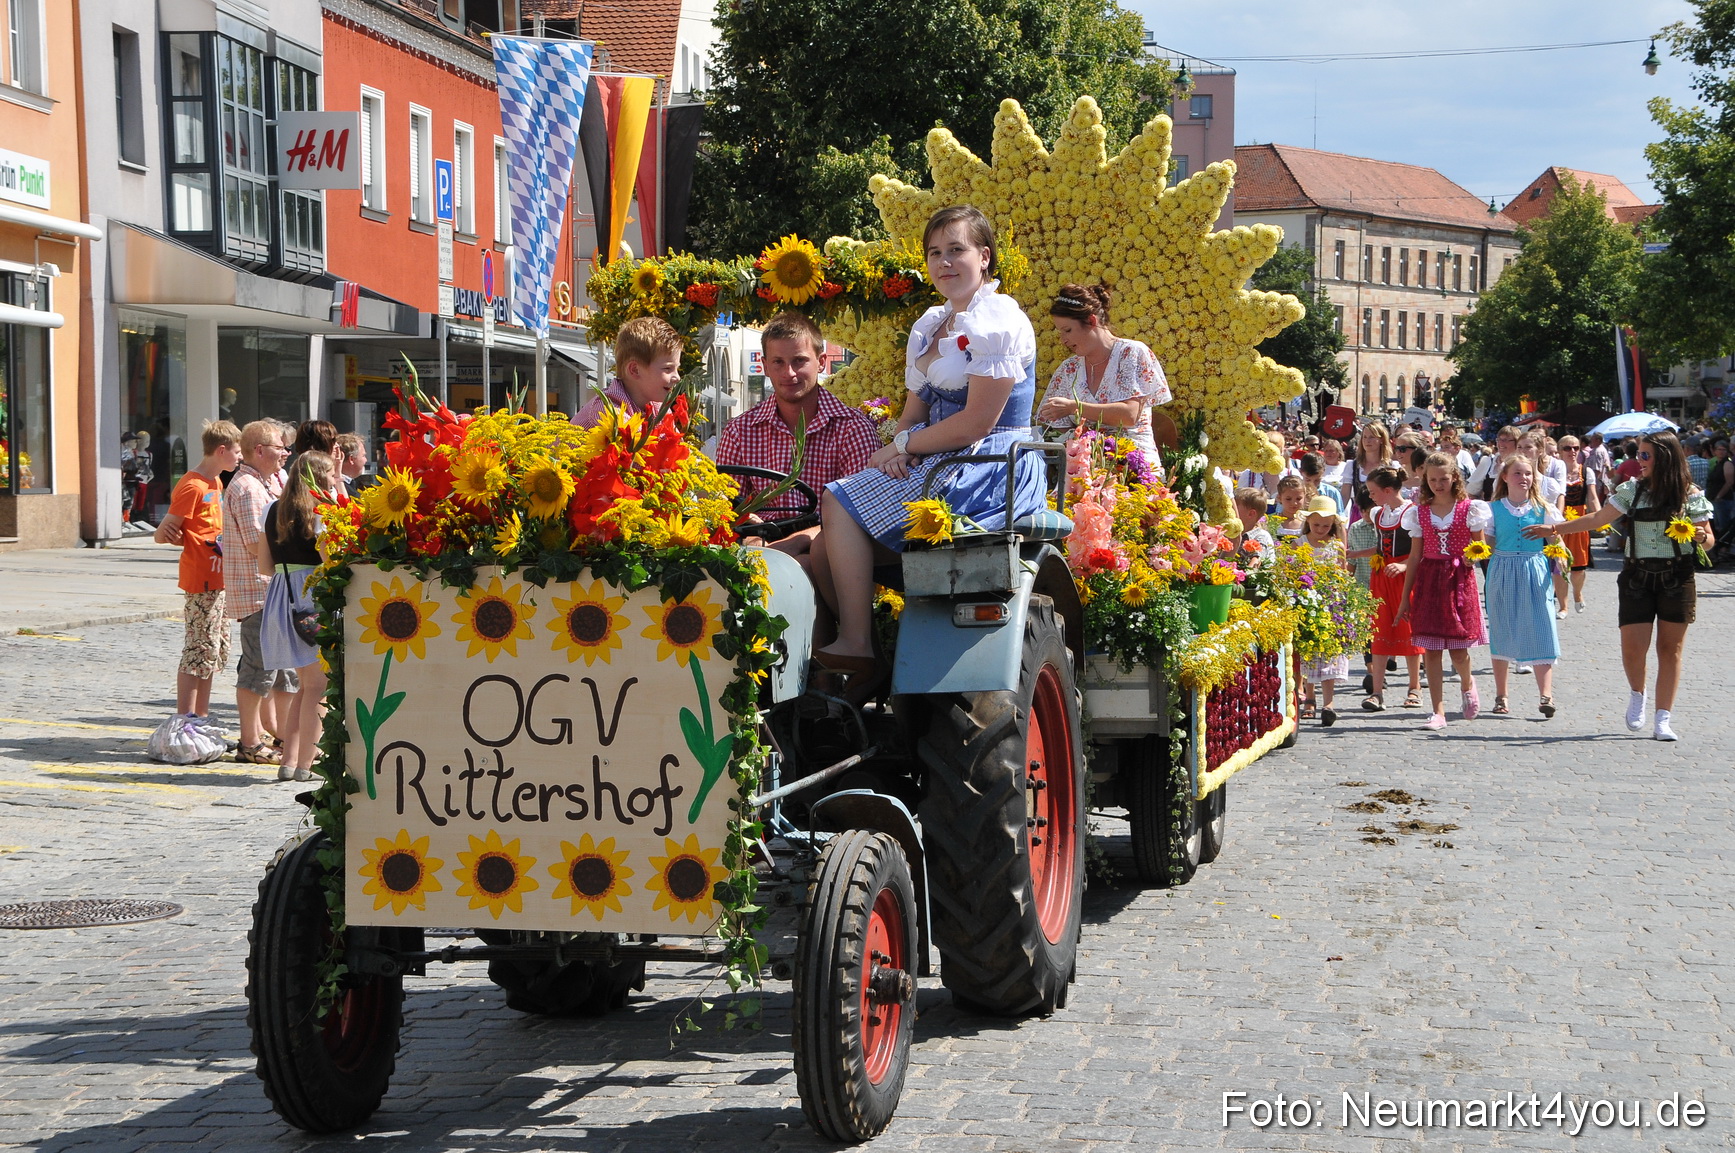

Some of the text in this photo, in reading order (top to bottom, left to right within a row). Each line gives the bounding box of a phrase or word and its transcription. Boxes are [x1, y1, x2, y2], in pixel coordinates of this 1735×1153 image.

[286, 129, 350, 172] H&M
[0, 160, 45, 197] rün Punkt
[439, 167, 449, 211] P
[750, 352, 761, 362] EC
[462, 673, 639, 747] OGV
[376, 740, 684, 837] Rittershof
